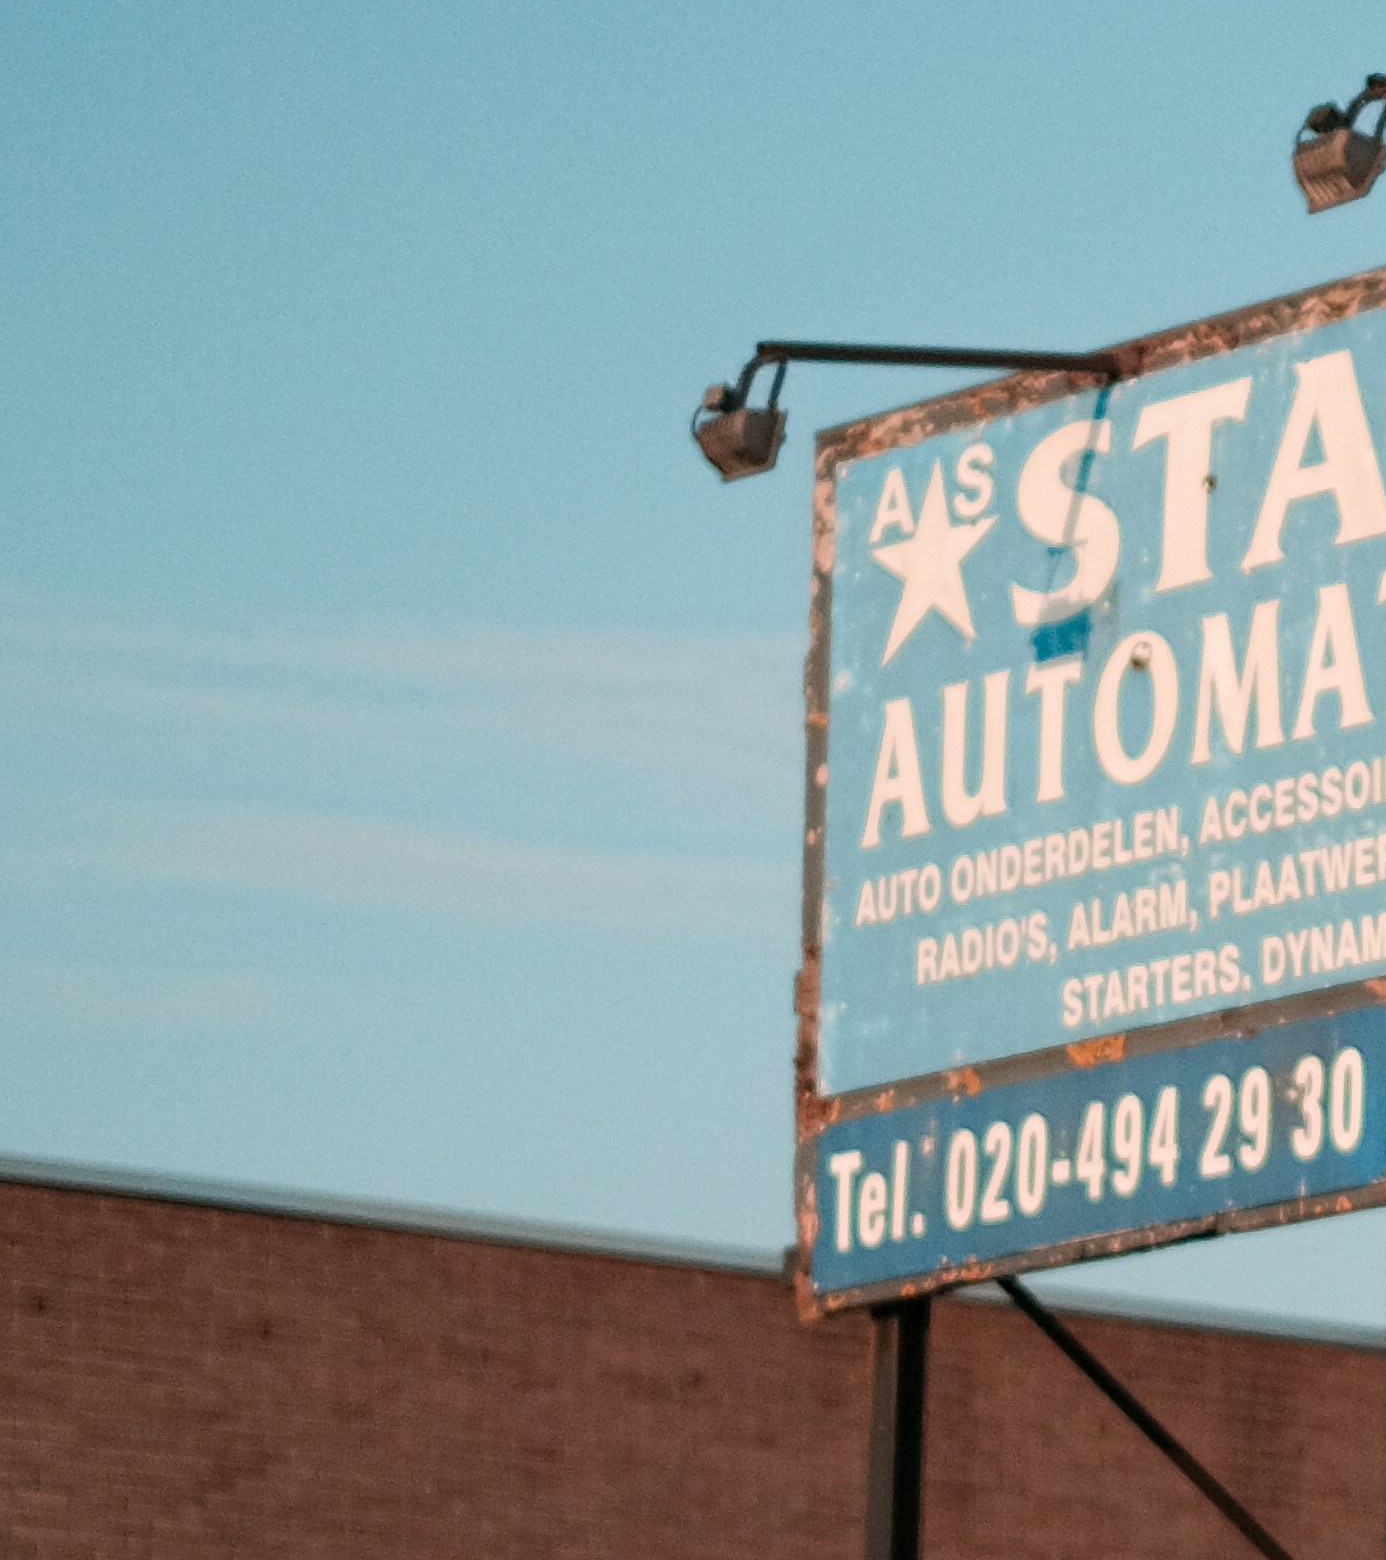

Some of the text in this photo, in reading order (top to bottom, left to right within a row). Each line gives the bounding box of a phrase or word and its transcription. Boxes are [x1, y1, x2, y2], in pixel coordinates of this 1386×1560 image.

[854, 864, 941, 927] AUTO
[951, 806, 1190, 903] ONDERDELEN,
[915, 912, 1058, 985] RADIO'S,
[1067, 879, 1198, 950] ALARM,
[829, 1045, 1365, 1255] Tel. 020-494 29 30
